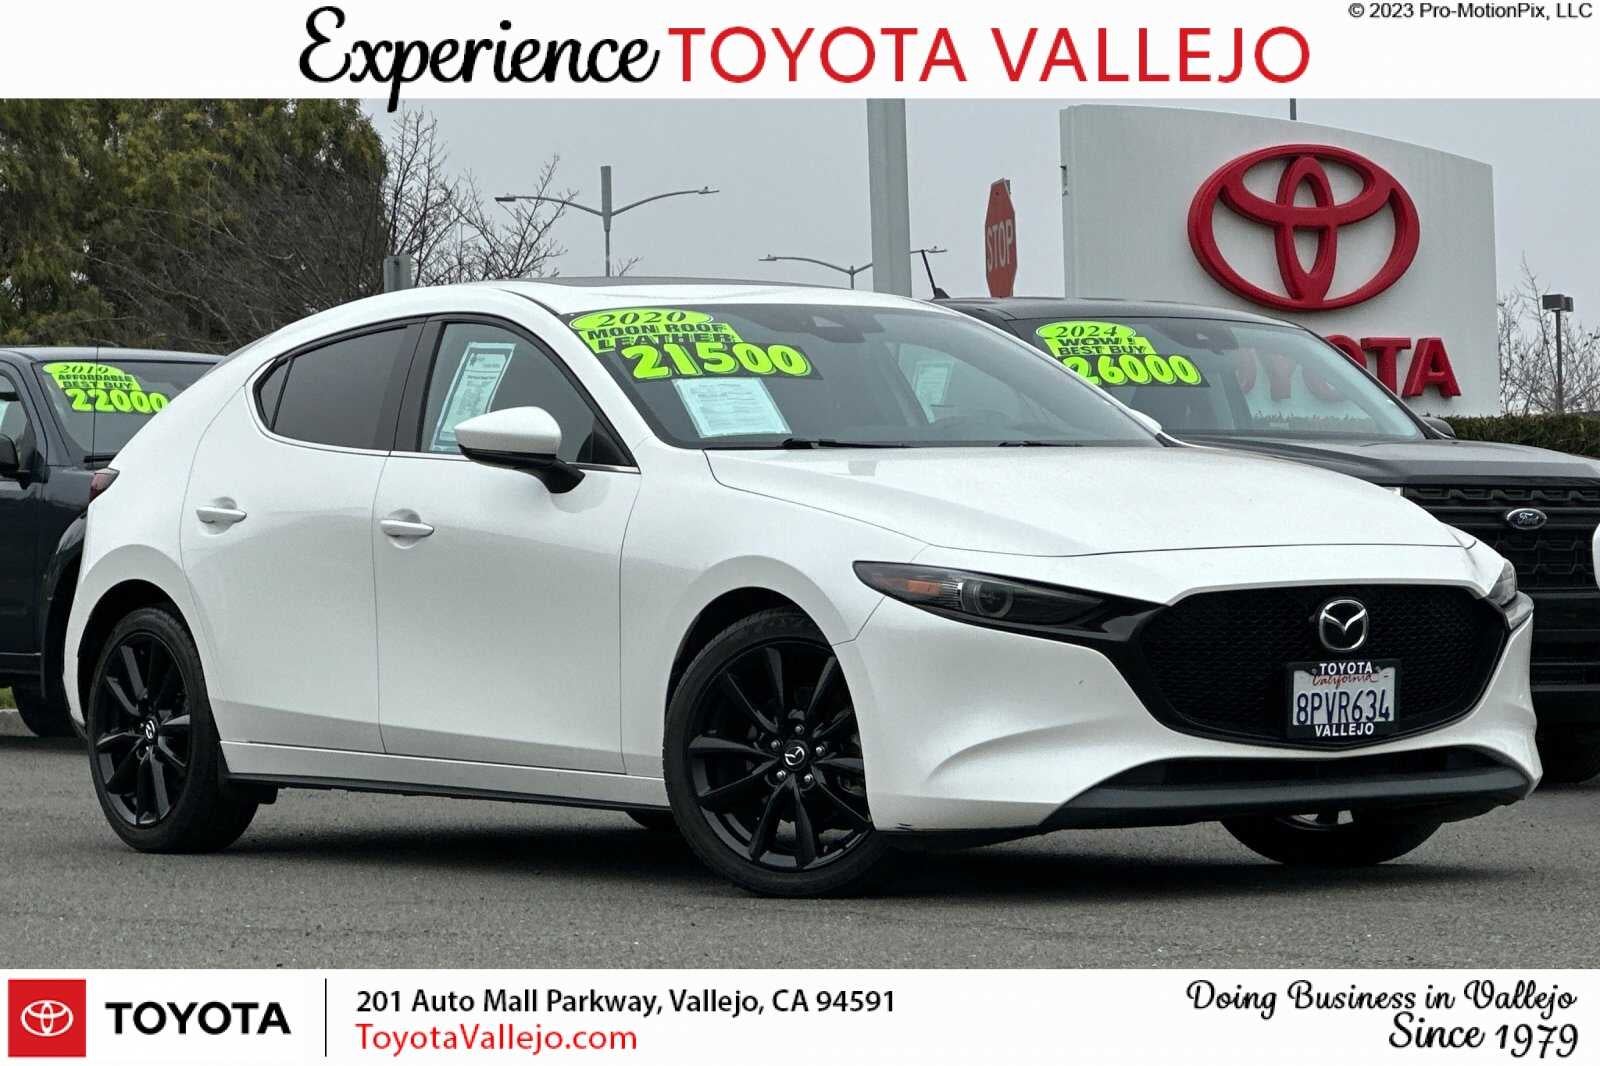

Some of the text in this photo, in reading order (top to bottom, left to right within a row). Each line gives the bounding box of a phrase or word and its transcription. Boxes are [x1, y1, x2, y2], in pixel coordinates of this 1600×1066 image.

[987, 219, 1013, 272] STOP
[597, 311, 687, 328] 2020
[587, 323, 727, 341] MOON ROOF
[1055, 325, 1118, 338] 2024
[598, 333, 733, 350] LEATHER
[1057, 345, 1147, 355] BEST BUY
[621, 341, 811, 380] 21500
[58, 374, 135, 382] AFFORDABLE
[59, 364, 110, 375] 2019
[1062, 354, 1202, 386] 26000
[62, 381, 133, 389] BEST BUY
[65, 389, 169, 413] 22000
[1319, 662, 1374, 675] TOYOTA
[1296, 689, 1391, 724] 8PVR634
[1315, 722, 1375, 736] VALLEJO
